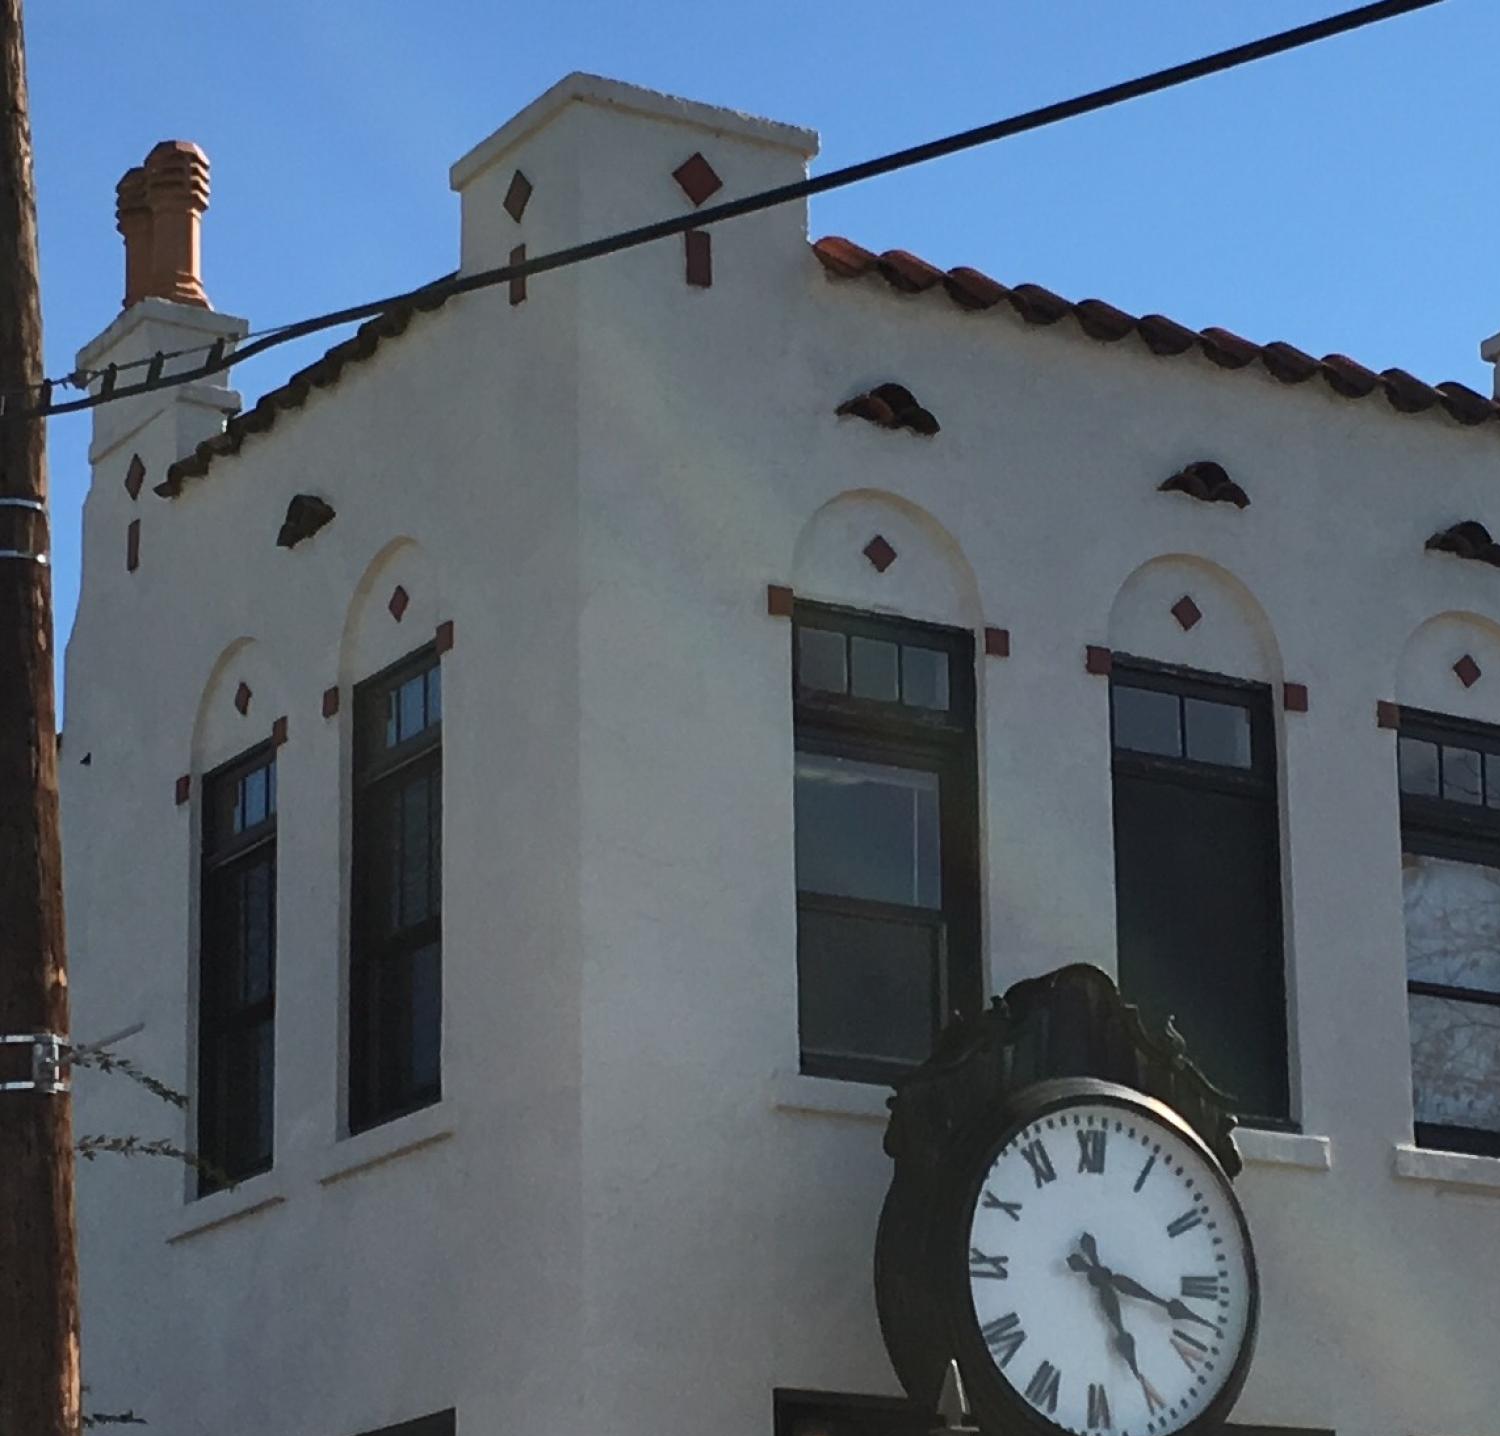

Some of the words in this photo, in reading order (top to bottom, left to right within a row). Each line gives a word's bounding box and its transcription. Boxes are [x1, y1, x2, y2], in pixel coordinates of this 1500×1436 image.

[1021, 1138, 1057, 1188] XI
[1077, 1129, 1107, 1175] XII
[982, 1190, 1023, 1222] X
[1166, 1208, 1203, 1238] II
[969, 1247, 1010, 1280] IX
[1181, 1275, 1219, 1299] III
[983, 1312, 1027, 1369] VIII
[1025, 1359, 1062, 1414] VII
[1086, 1383, 1111, 1430] VI
